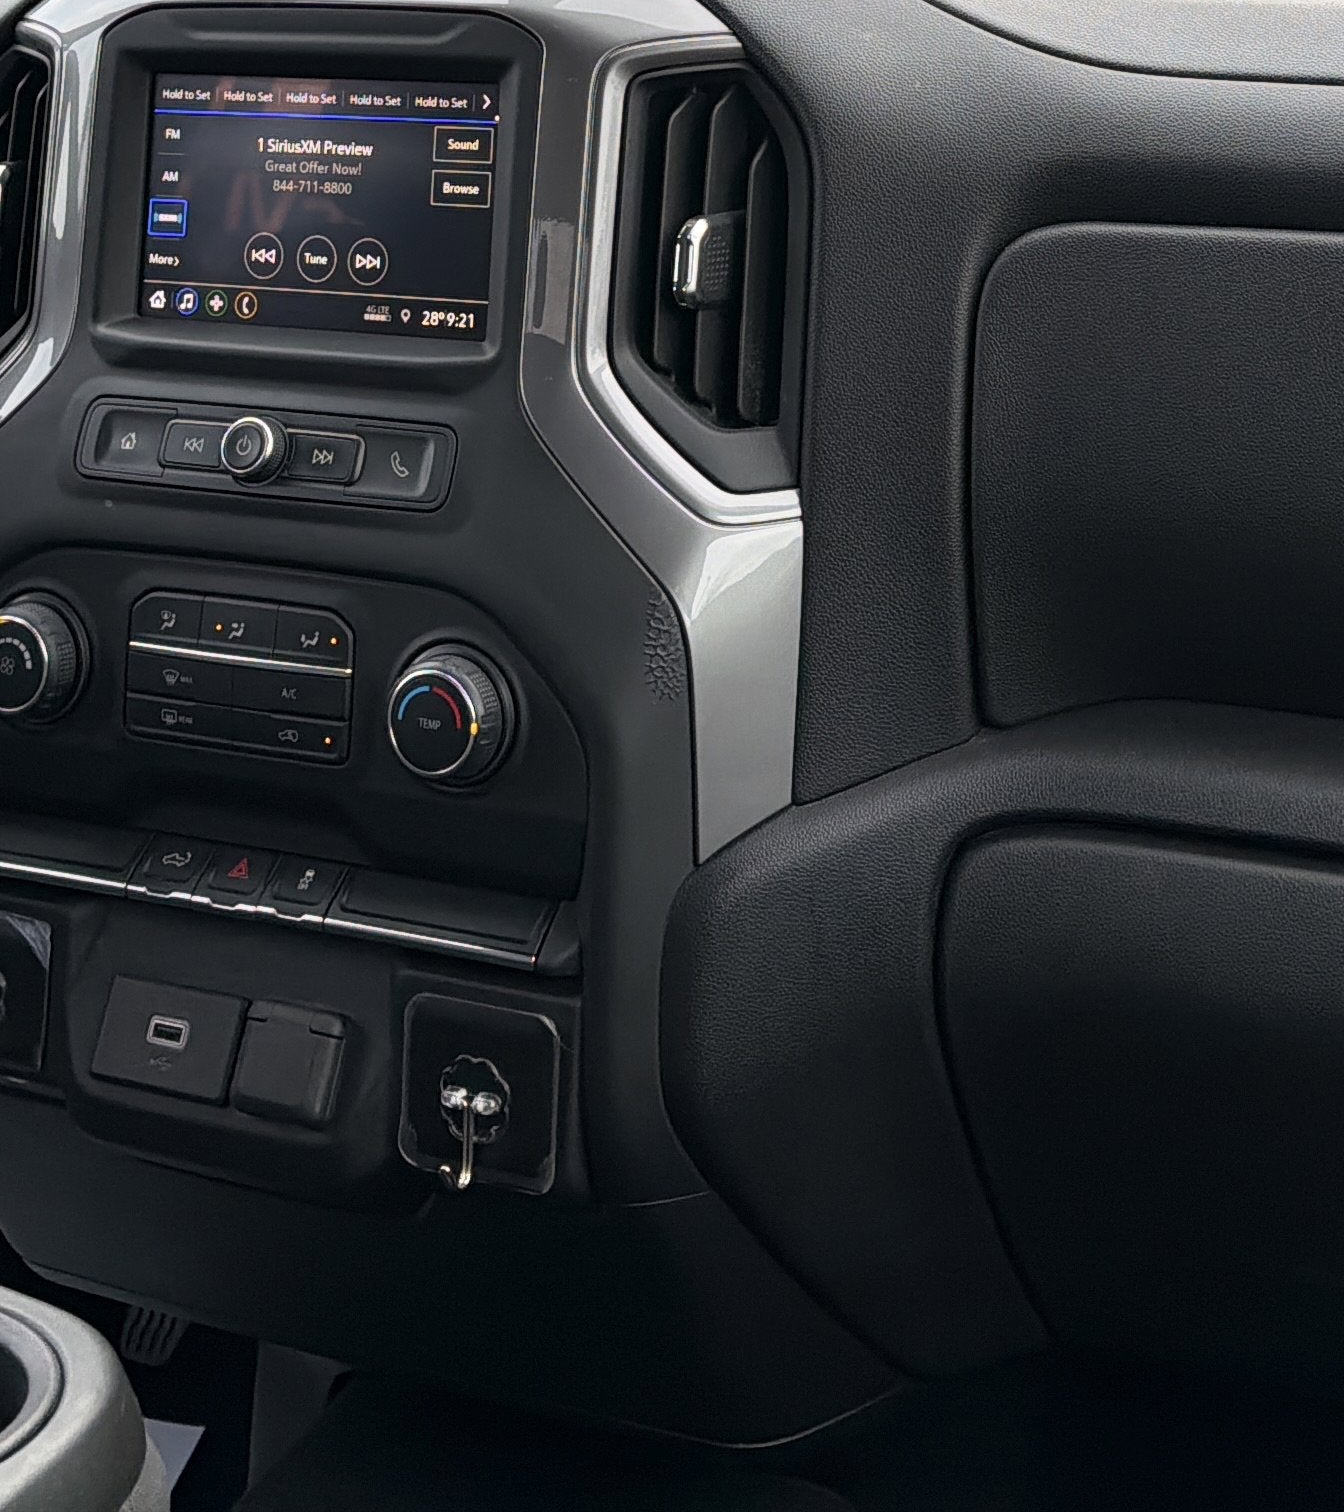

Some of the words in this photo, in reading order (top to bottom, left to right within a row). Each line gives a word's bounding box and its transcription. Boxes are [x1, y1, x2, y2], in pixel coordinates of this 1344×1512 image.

[162, 89, 184, 100] Hold
[184, 90, 195, 100] to
[196, 90, 211, 101] Set
[223, 91, 245, 102] Hold
[245, 92, 257, 102] to
[257, 92, 273, 103] Set
[286, 92, 308, 104] Hold
[308, 93, 320, 104] to
[320, 94, 337, 105] Set
[349, 94, 372, 106] Hold
[373, 95, 384, 106] to
[385, 95, 402, 107] Set
[414, 96, 438, 108] Hold
[439, 97, 450, 108] to
[451, 98, 468, 109] Set
[164, 129, 181, 140] FM
[257, 137, 264, 153] 1
[267, 138, 321, 155] SiriusXM
[323, 140, 374, 157] Preview
[447, 140, 480, 152] Sound
[265, 159, 297, 173] Great
[299, 161, 329, 174] Offer
[332, 162, 362, 176] Now!
[161, 170, 179, 183] AM
[272, 179, 353, 195] 844-711-8800
[442, 182, 480, 195] Browse
[148, 253, 175, 265] More
[303, 252, 329, 266] Tune
[365, 305, 377, 314] 4G
[377, 306, 391, 315] LTE
[446, 312, 475, 329] 9:21
[281, 687, 298, 700] A/C
[417, 716, 443, 732] TEMP
